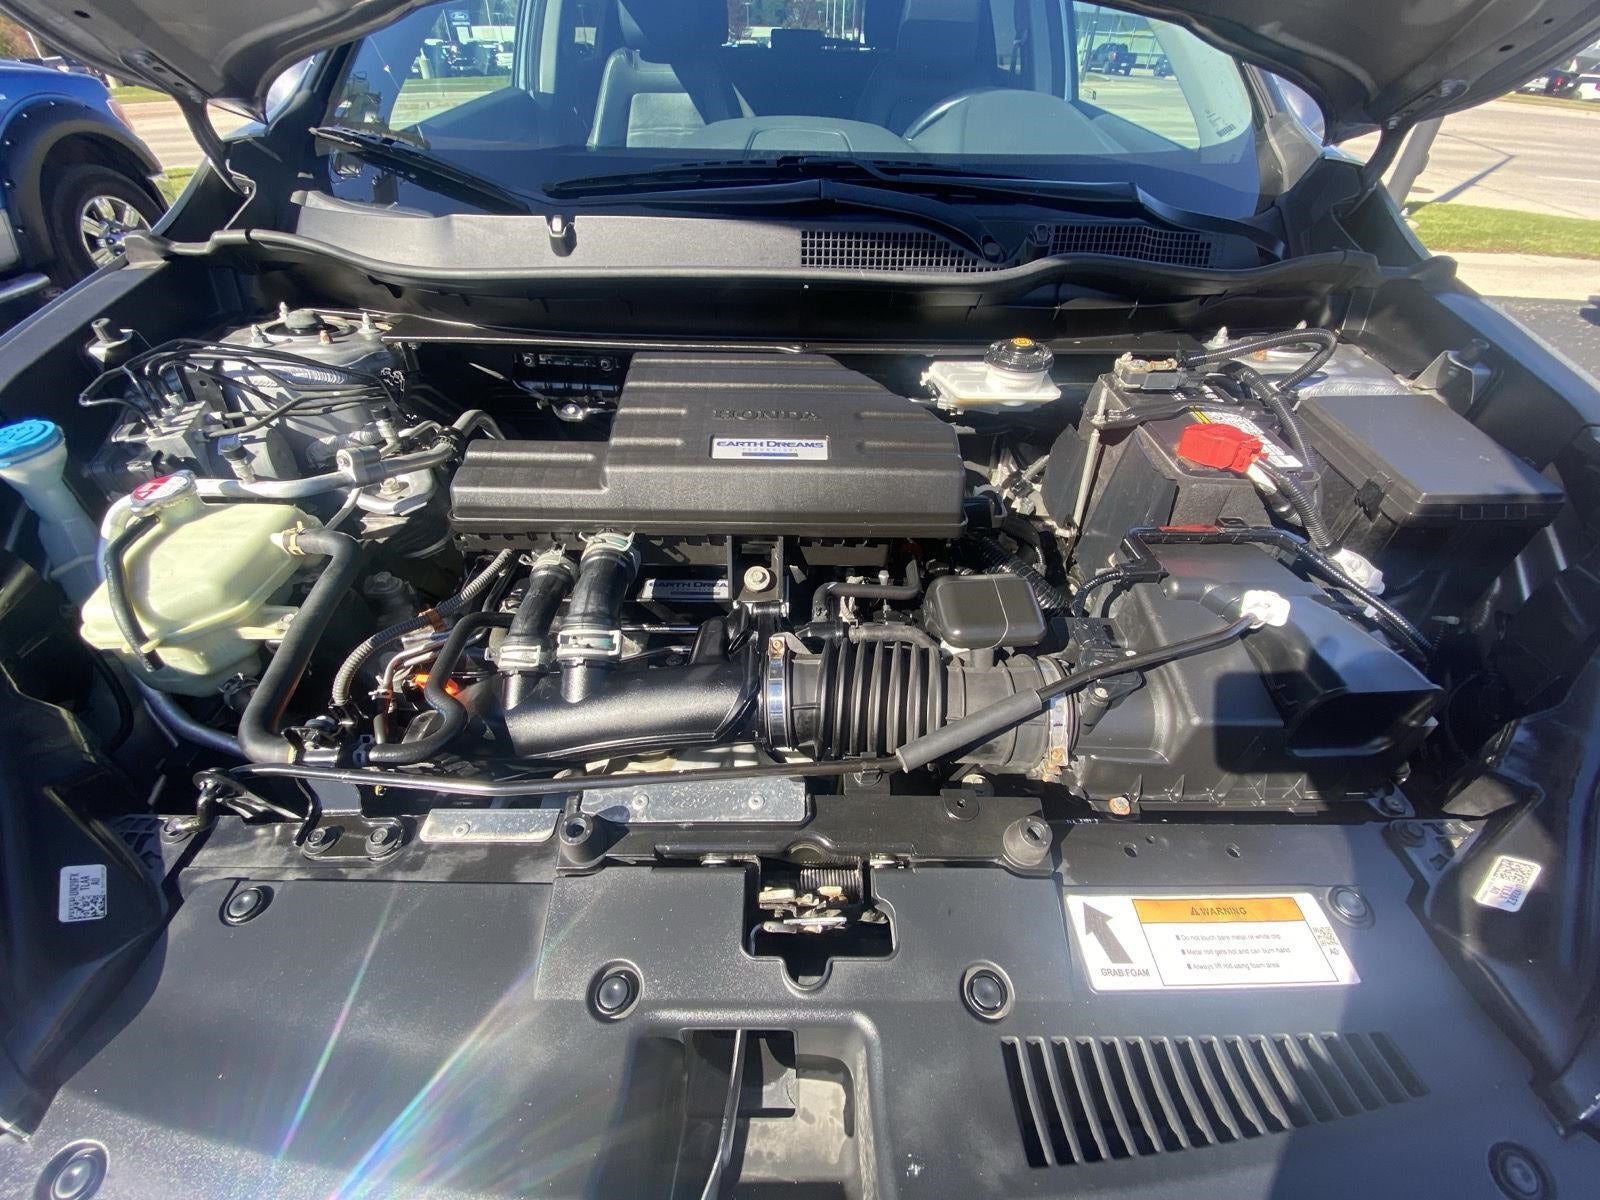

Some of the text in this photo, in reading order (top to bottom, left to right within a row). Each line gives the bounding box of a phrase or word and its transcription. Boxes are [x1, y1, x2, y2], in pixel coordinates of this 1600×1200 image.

[713, 408, 820, 420] HONDA
[716, 440, 824, 448] EARTH DREAMS
[1200, 907, 1247, 916] WARNING
[1101, 967, 1151, 977] GRAB FOAM
